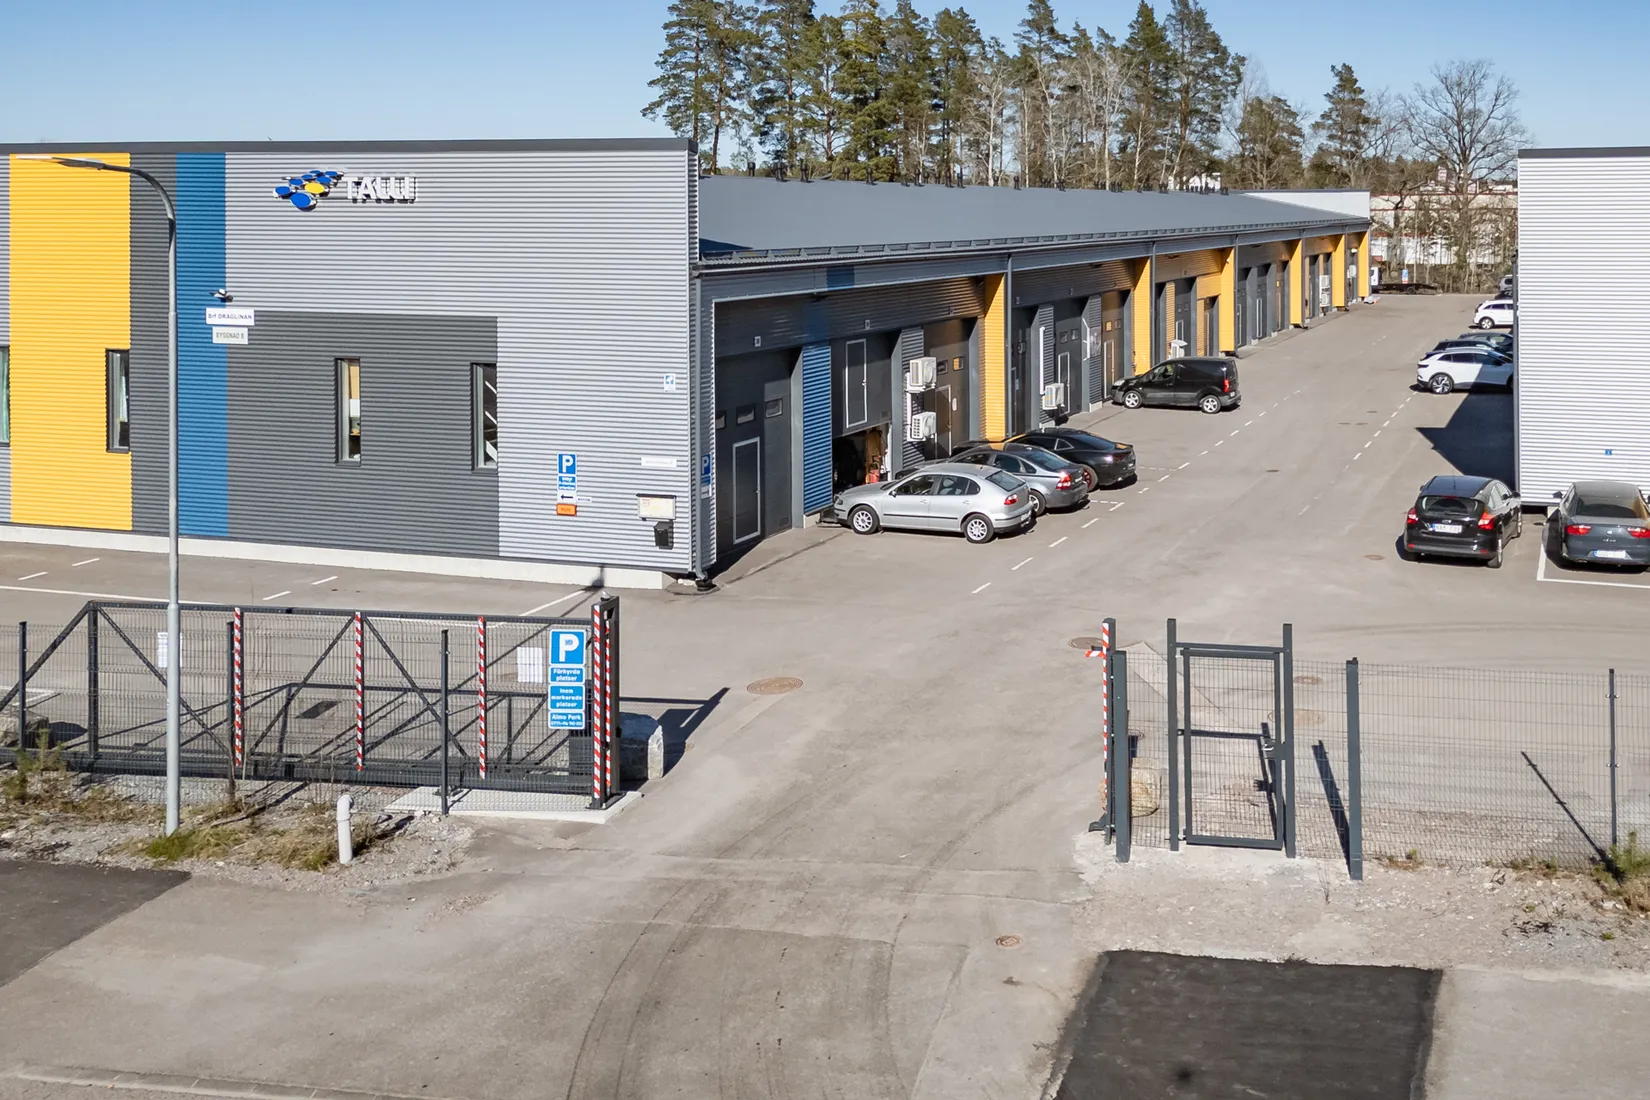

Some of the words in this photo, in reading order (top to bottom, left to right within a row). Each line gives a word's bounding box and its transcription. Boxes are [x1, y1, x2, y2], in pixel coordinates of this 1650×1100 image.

[341, 176, 412, 200] TALLI
[562, 455, 574, 473] P
[701, 456, 709, 474] P
[559, 633, 580, 662] P
